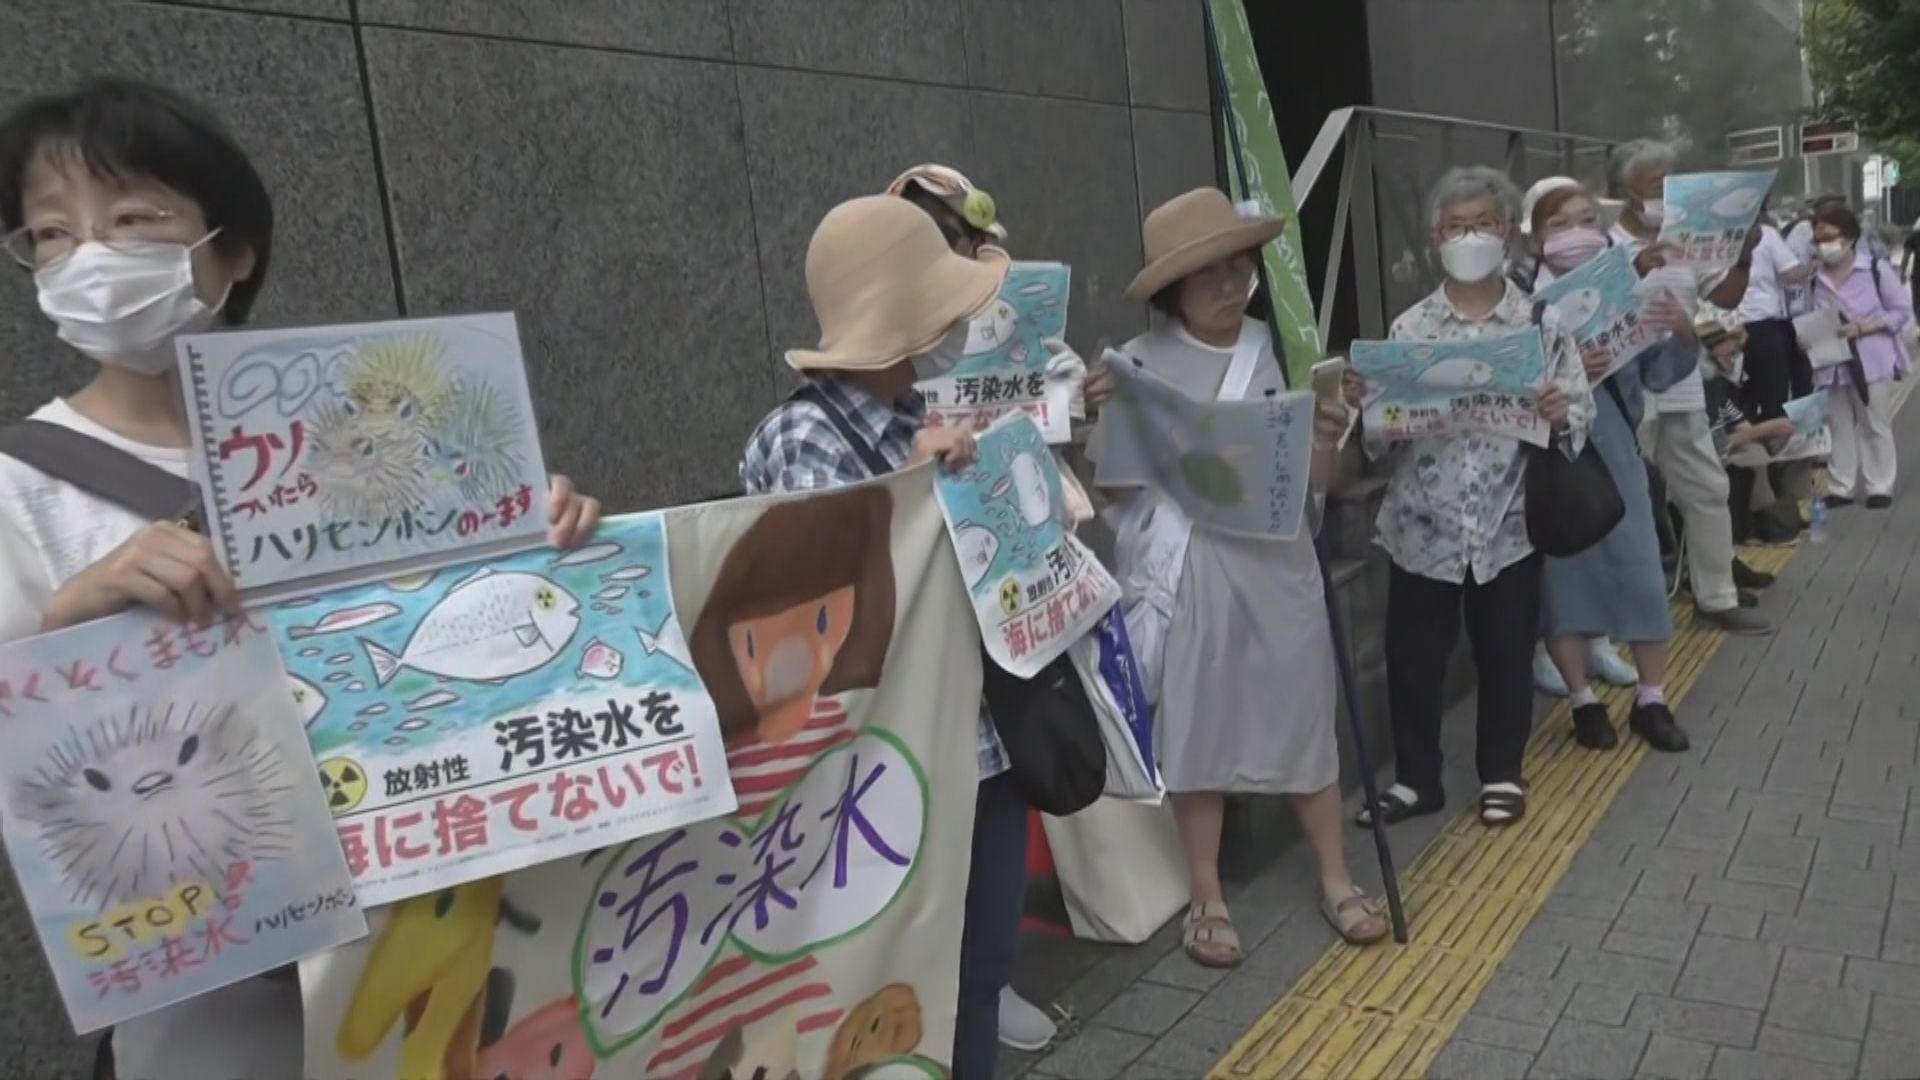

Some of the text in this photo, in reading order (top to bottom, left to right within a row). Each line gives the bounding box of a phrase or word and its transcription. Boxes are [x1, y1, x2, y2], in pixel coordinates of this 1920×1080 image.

[955, 372, 1045, 405] 汚染水を
[219, 420, 305, 492] ウソ
[231, 472, 319, 520] ついたら
[383, 690, 686, 797] 放射性 汚染水を
[592, 753, 912, 1018] 汚染水
